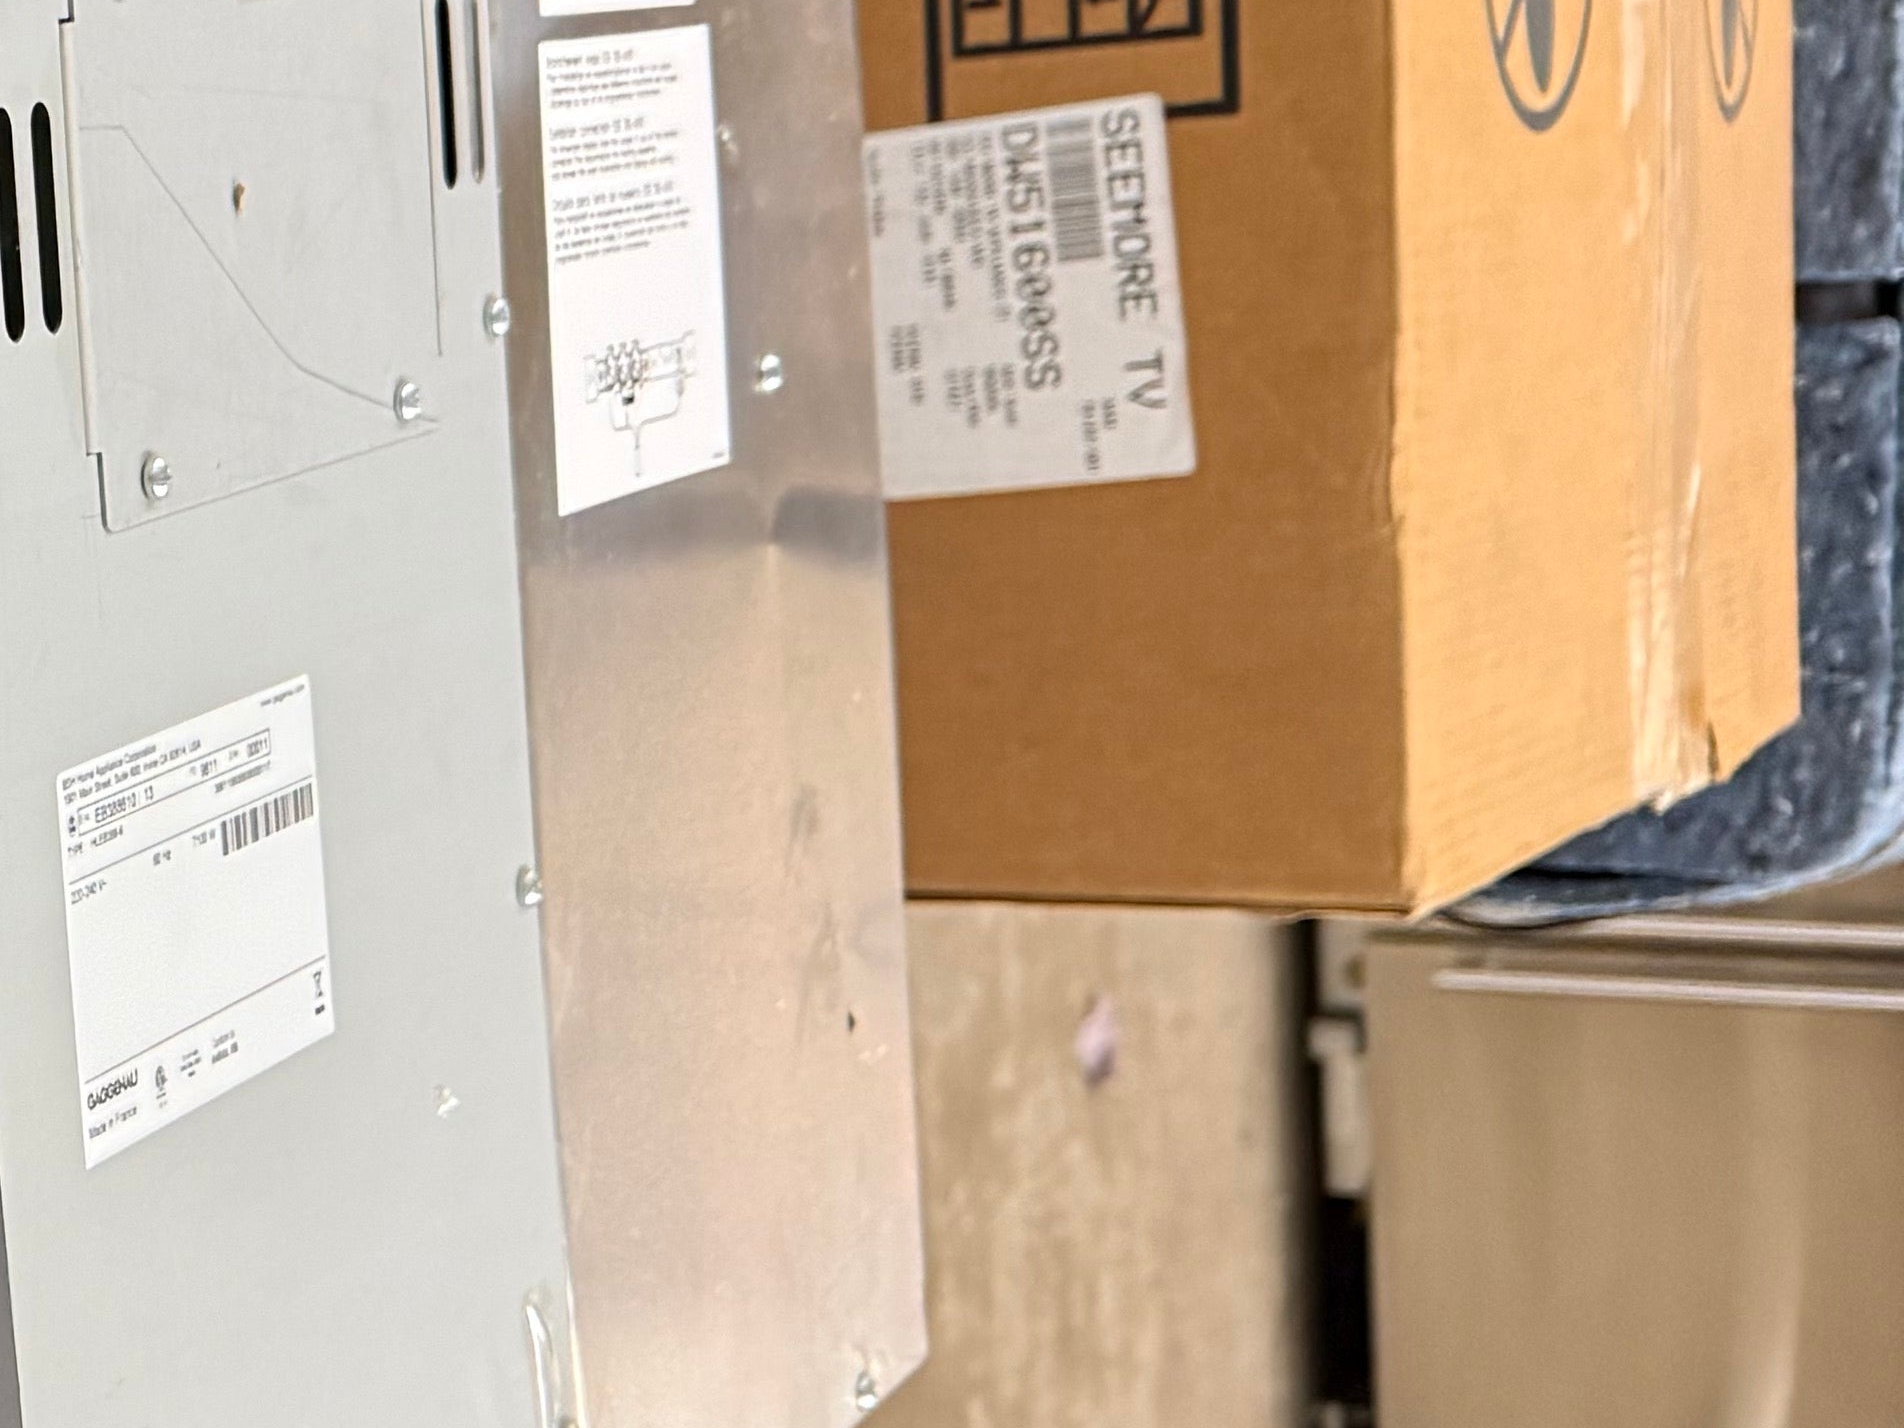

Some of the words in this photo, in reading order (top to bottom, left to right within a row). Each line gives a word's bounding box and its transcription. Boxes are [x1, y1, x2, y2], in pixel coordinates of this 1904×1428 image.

[1099, 108, 1158, 322] SEEMORE
[1124, 347, 1169, 410] TV
[87, 1068, 139, 1111] GAGGENAU
